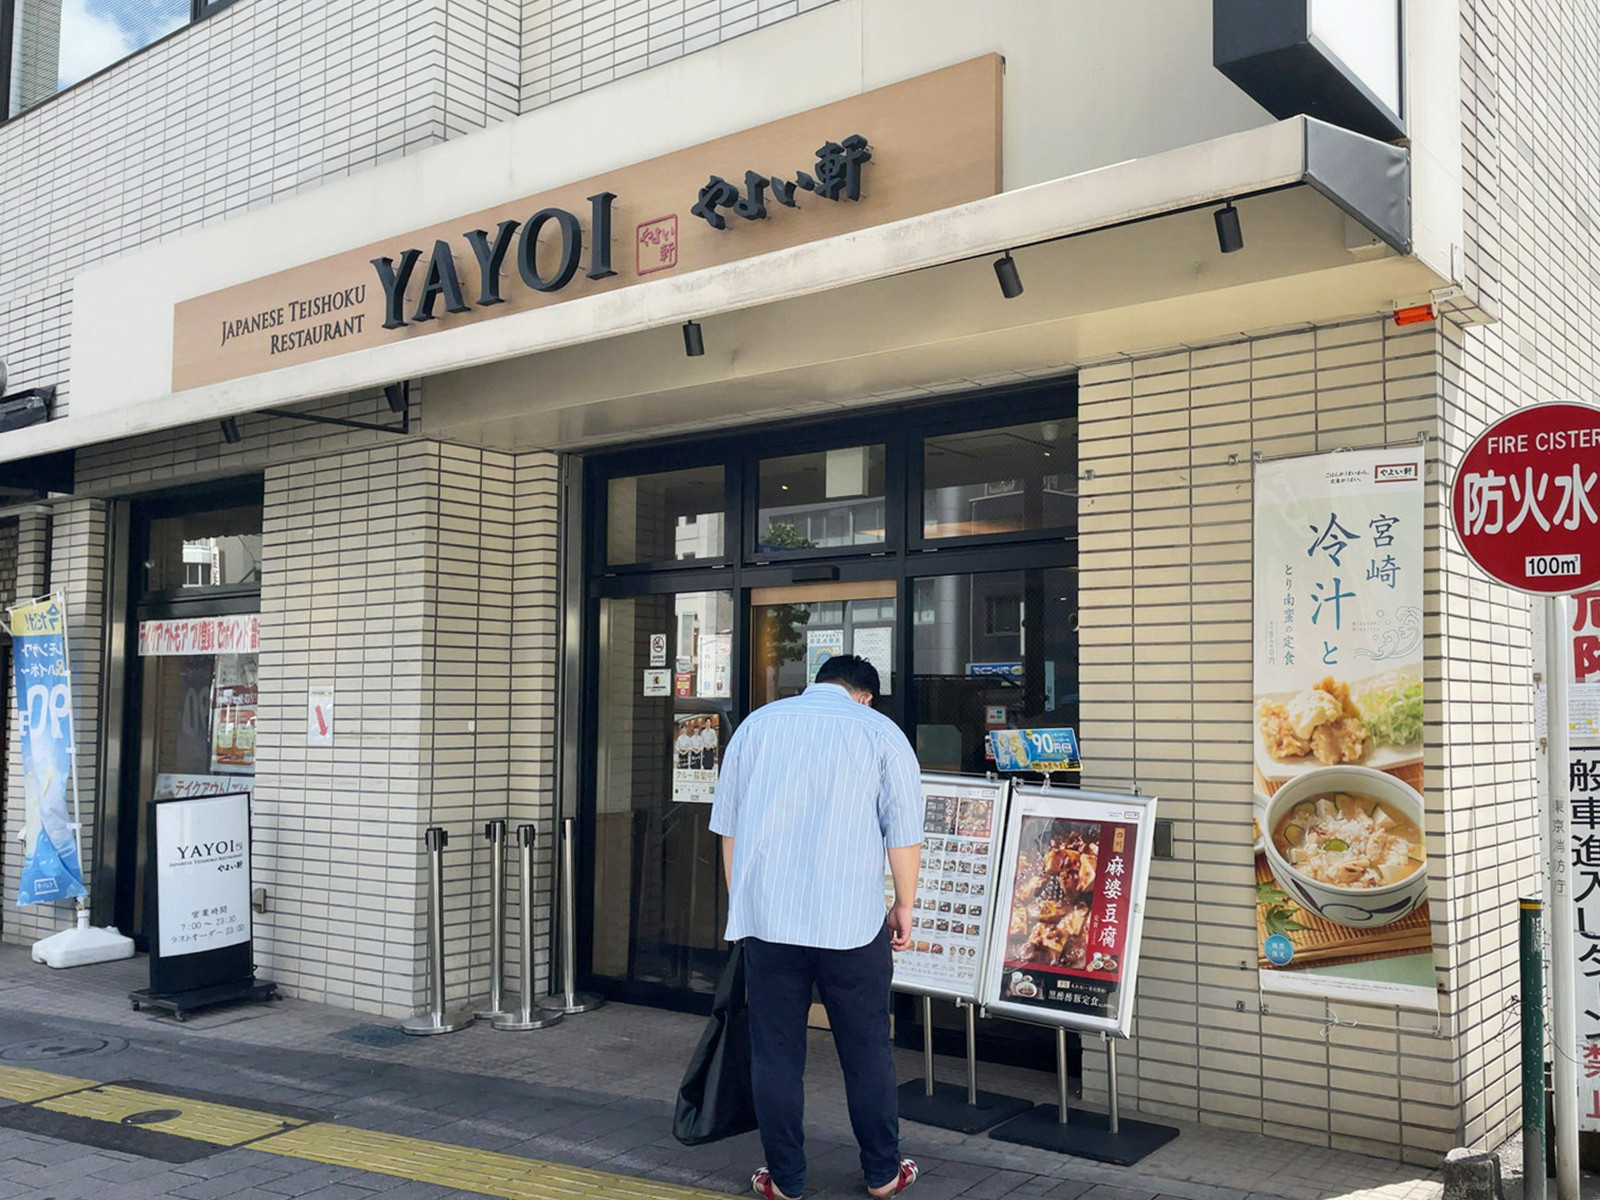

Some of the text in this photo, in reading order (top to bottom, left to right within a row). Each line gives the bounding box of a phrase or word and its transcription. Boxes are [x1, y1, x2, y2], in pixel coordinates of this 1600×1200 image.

[691, 134, 871, 230] やよい軒
[370, 192, 618, 329] YAYOI
[640, 227, 675, 247] やよい
[660, 243, 676, 262] 軒
[221, 285, 366, 346] JAPANESE TEISHOKU
[270, 315, 365, 355] RESTAURANT
[1380, 467, 1412, 476] やよい軒
[1487, 433, 1529, 455] FIRE
[1463, 463, 1600, 536] 防火水
[1366, 514, 1401, 588] 宮崎
[1283, 564, 1295, 666] とり南蛮の定食
[1307, 512, 1361, 665] 冷汁と
[177, 840, 234, 859] YAYOI
[1552, 799, 1566, 894] 東京消防庁
[191, 905, 228, 919] 営業時間
[1098, 855, 1125, 948] 麻婆豆腐
